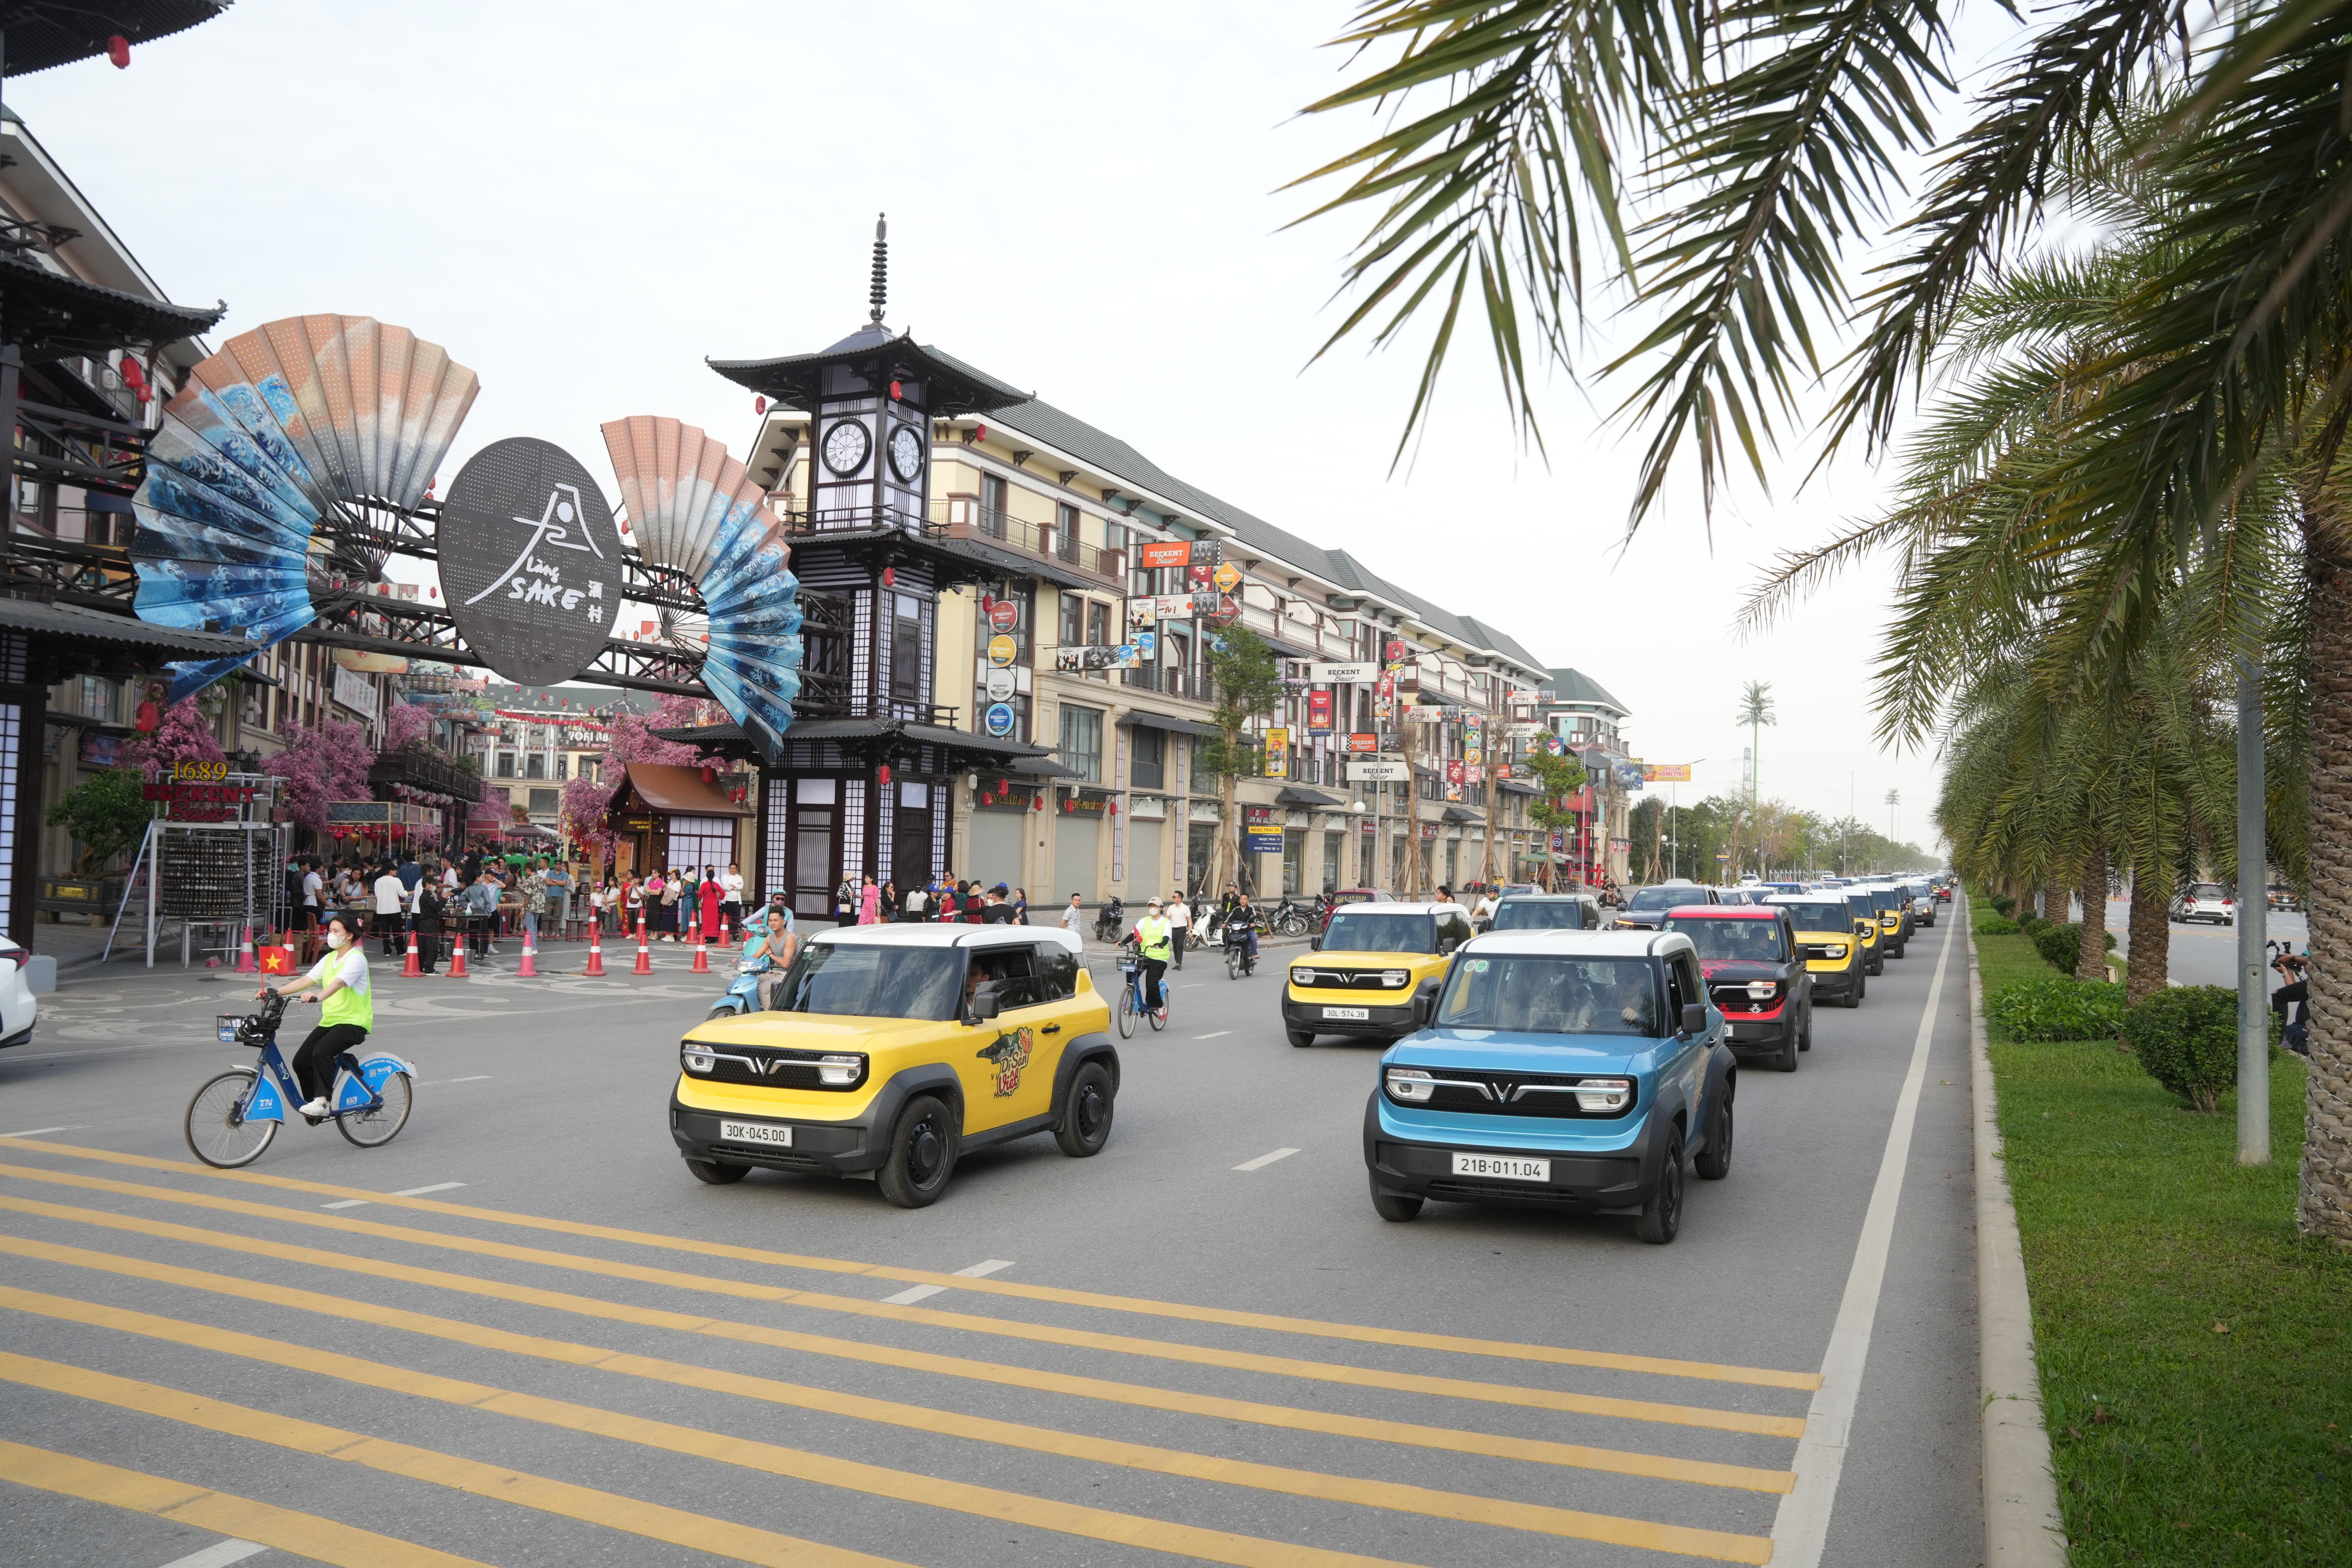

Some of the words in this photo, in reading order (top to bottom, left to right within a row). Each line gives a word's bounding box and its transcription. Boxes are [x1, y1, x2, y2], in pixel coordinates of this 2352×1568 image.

[1156, 556, 1177, 564] Bauer
[507, 577, 586, 610] SAKE
[1158, 606, 1176, 614] ール!
[173, 761, 227, 781] 1689
[143, 783, 255, 803] BECKENT
[165, 799, 236, 822] Bauer
[1327, 1010, 1364, 1018] 30L-574.38
[1001, 1057, 1011, 1073] Di
[1012, 1050, 1026, 1068] Sản
[998, 1067, 1019, 1094] Việt
[259, 1098, 273, 1107] TN
[726, 1124, 785, 1142] 30K-045.00
[1461, 1158, 1540, 1177] 21B-011.04
